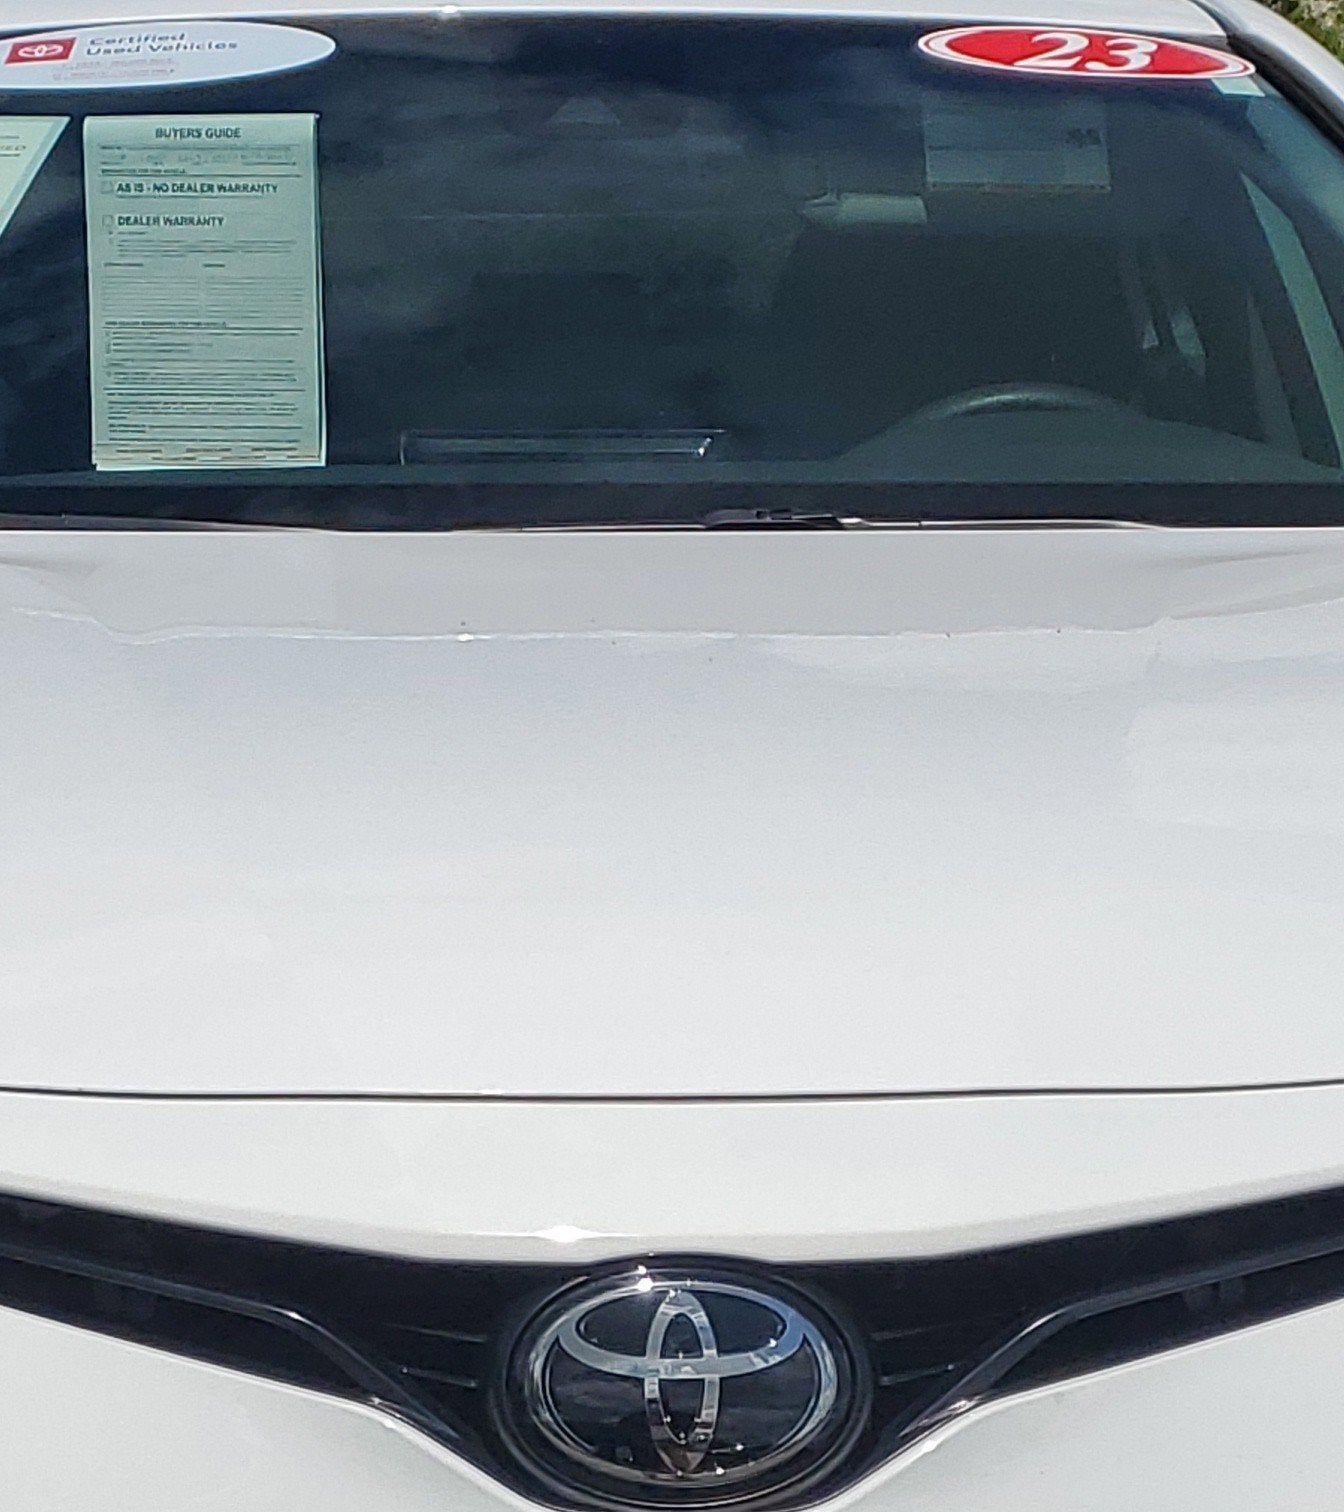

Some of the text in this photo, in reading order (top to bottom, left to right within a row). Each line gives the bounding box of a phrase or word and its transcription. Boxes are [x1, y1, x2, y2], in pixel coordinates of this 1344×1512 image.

[89, 32, 186, 46] Certified
[86, 39, 238, 56] Used Vehicles
[1013, 32, 1158, 71] 23
[155, 127, 242, 139] BUYERS GUIDE
[116, 183, 131, 194] AS
[133, 183, 145, 194] IS
[152, 183, 169, 194] NO
[171, 183, 215, 194] DEALER
[217, 183, 279, 194] WARRANTY
[117, 215, 225, 227] DEALER WARRANTY
